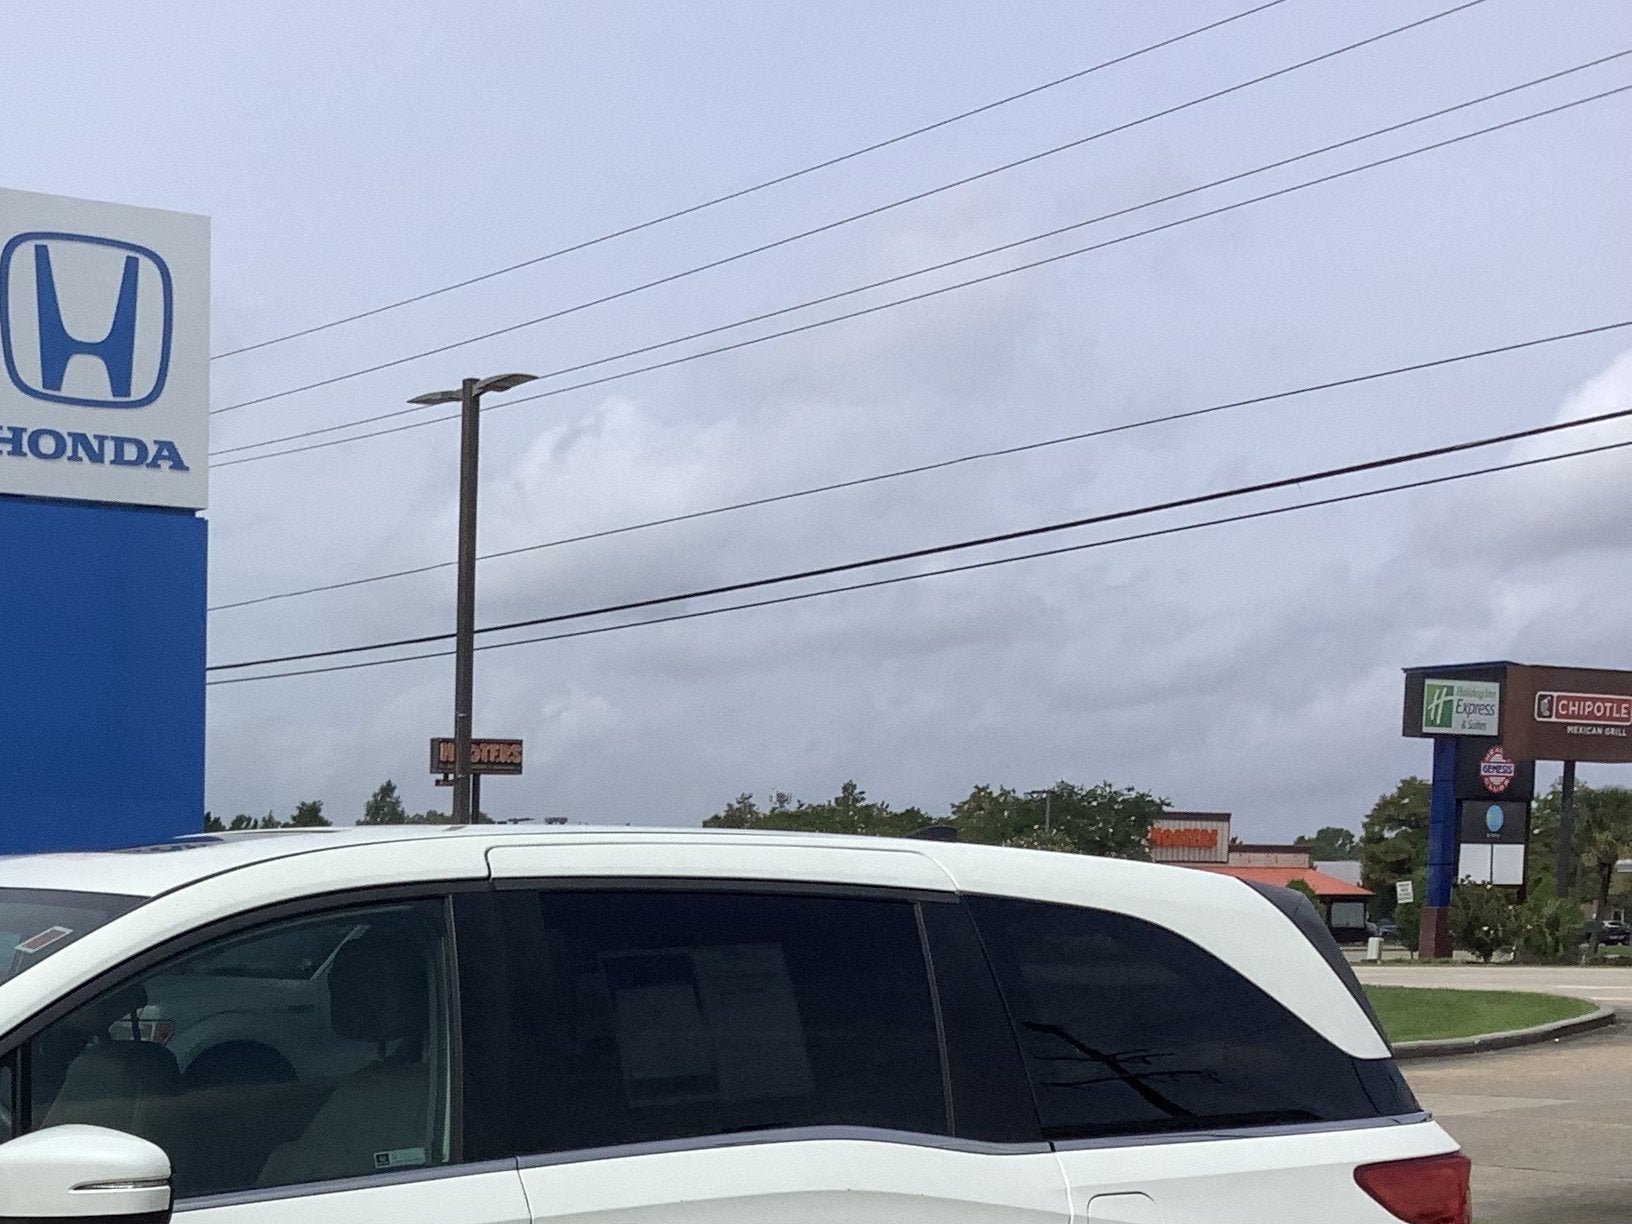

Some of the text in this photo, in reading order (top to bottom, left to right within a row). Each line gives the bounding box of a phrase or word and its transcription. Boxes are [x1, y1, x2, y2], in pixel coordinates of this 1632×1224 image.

[1456, 698, 1496, 718] Express
[1558, 700, 1629, 718] CHIPOTLE
[1567, 725, 1627, 736] MEXICAN GRILL
